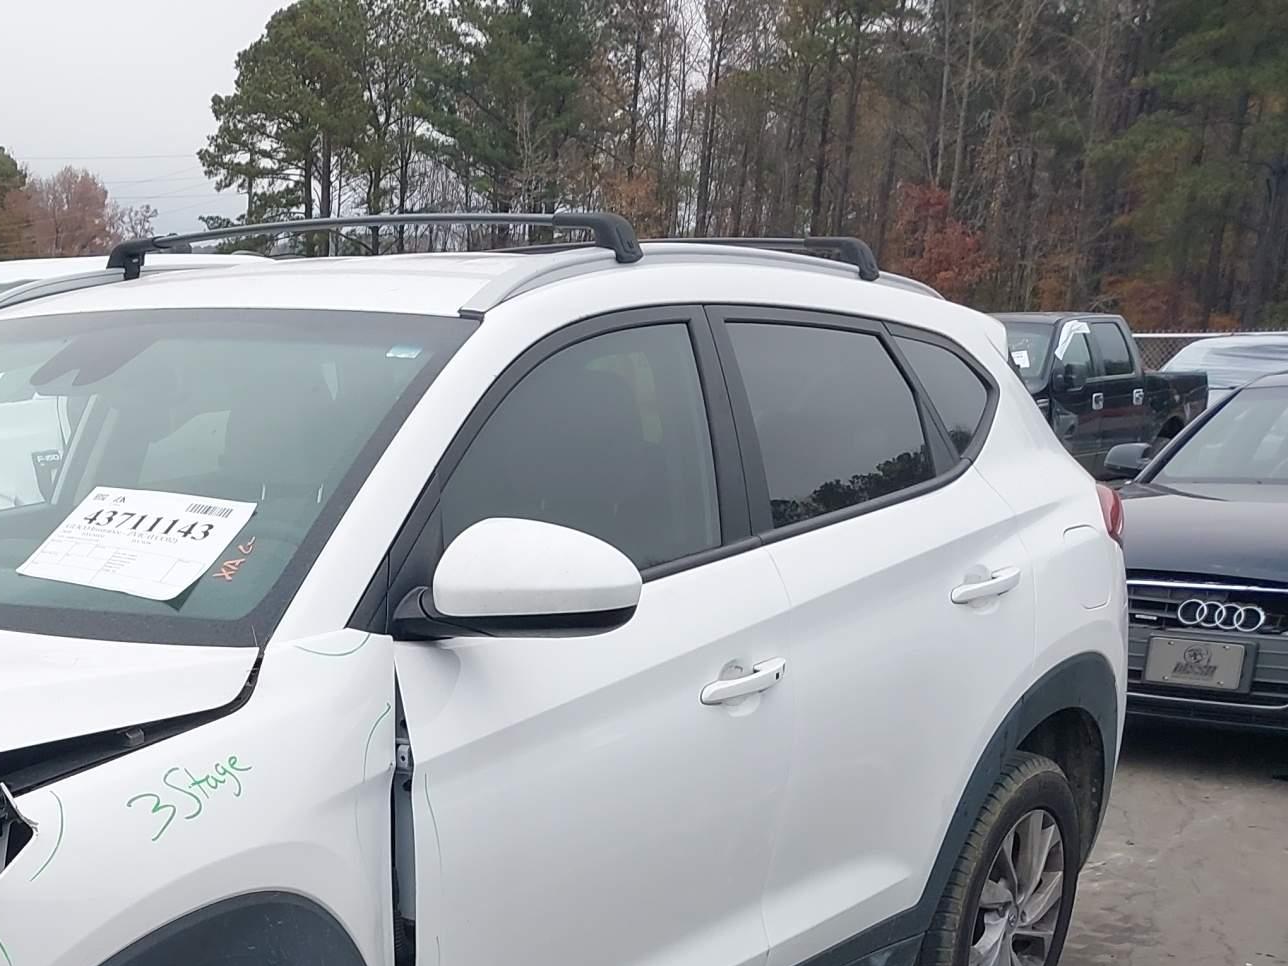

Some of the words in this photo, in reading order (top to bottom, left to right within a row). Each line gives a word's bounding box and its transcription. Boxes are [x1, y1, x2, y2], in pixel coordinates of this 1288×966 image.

[83, 508, 215, 541] 43711143
[126, 792, 177, 842] 3
[162, 755, 253, 820] Stage
